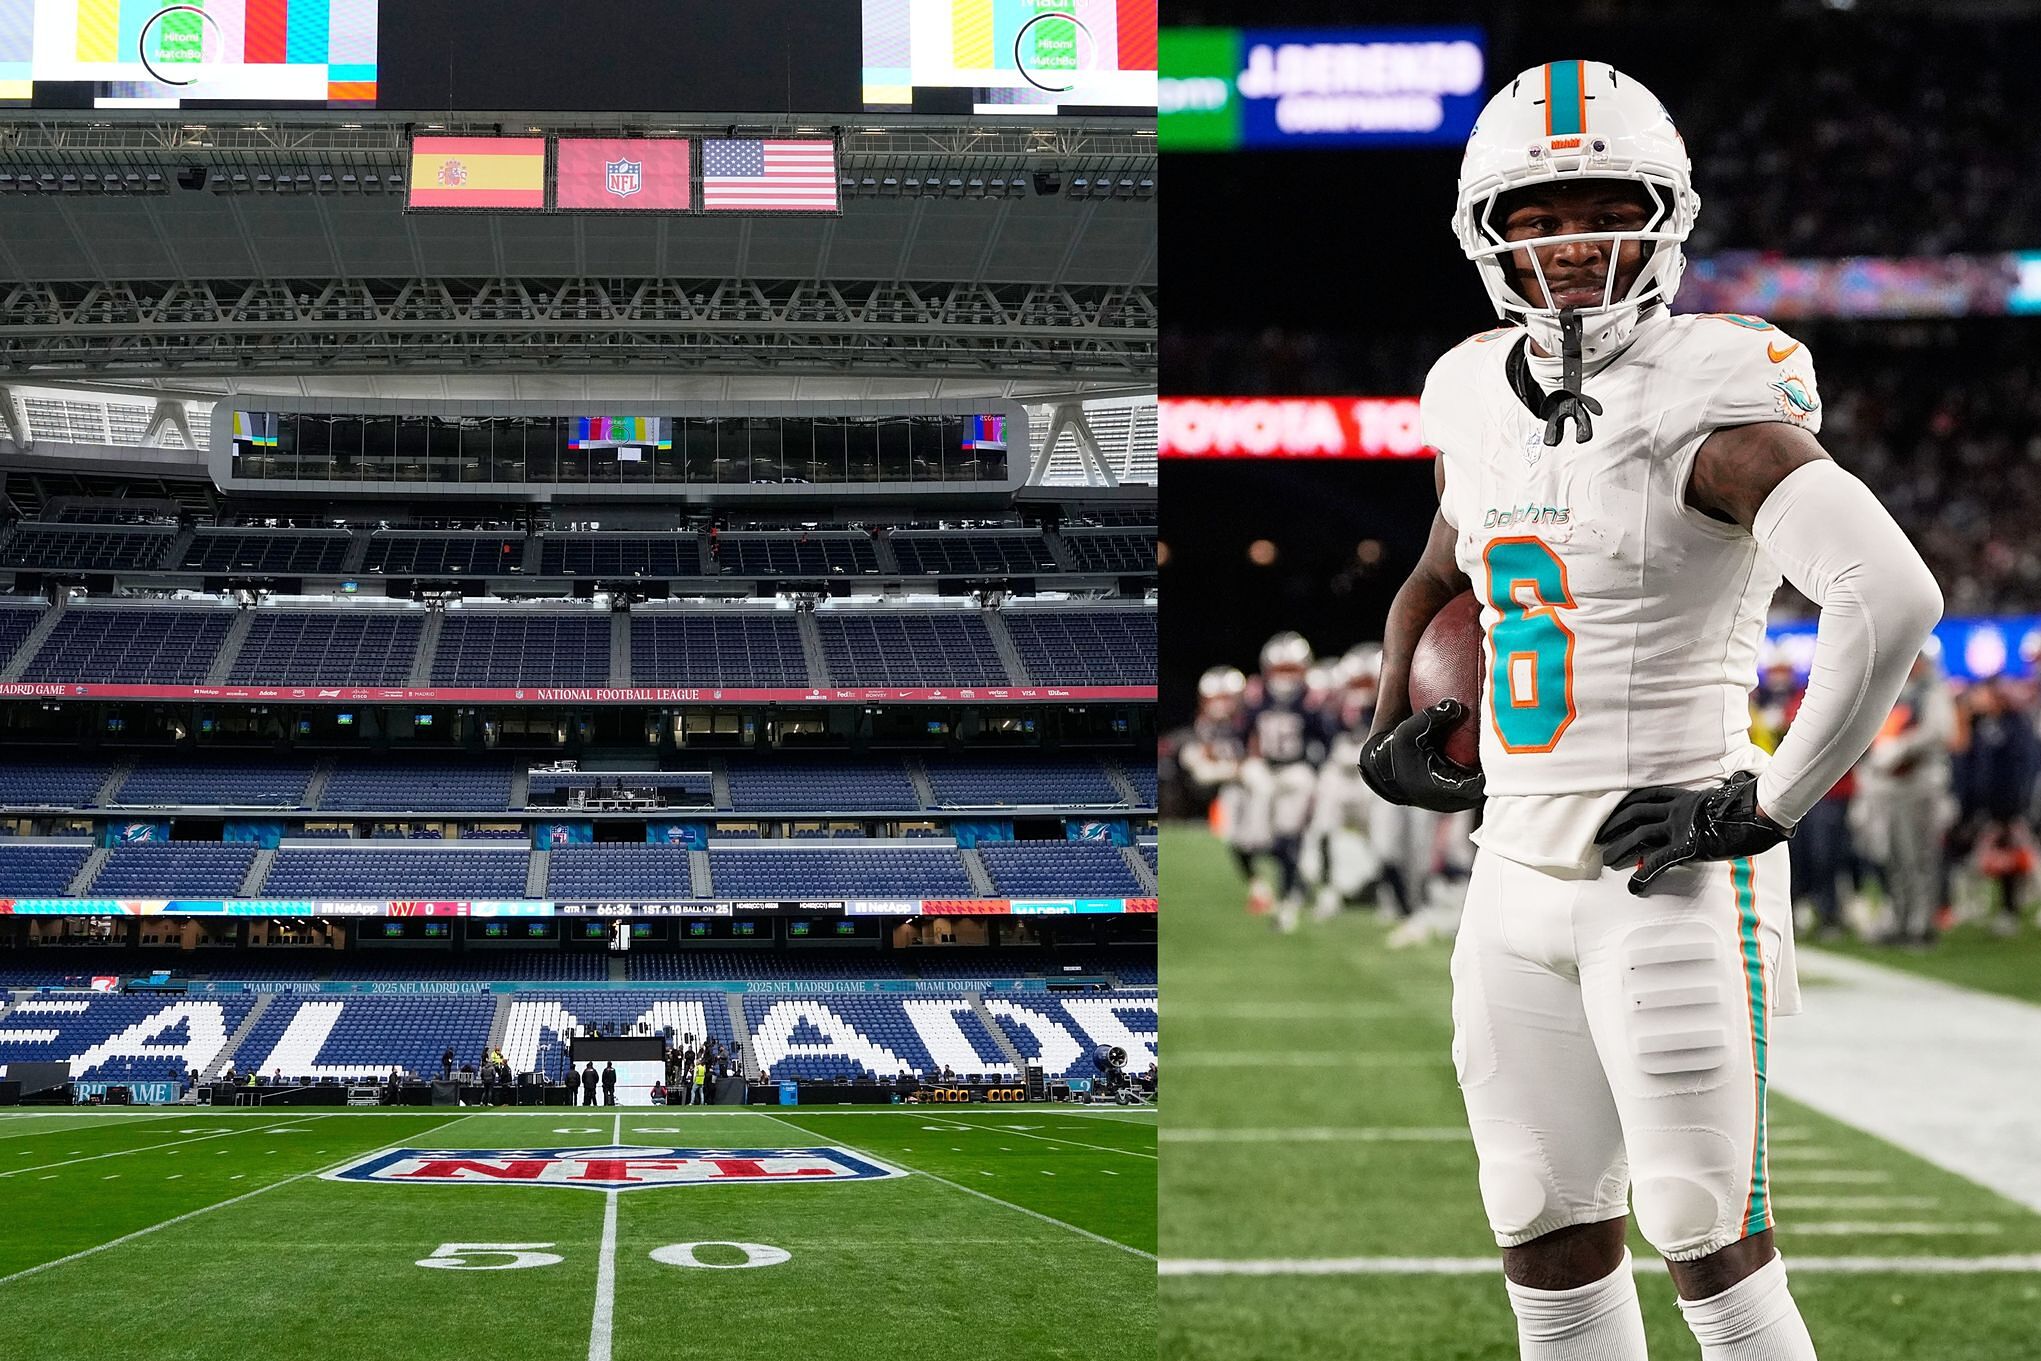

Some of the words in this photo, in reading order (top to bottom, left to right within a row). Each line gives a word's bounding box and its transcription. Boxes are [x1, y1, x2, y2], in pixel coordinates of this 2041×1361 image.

[164, 32, 199, 42] Hitomi
[1038, 39, 1073, 49] Hitomi
[1030, 56, 1082, 66] MatchBo
[610, 175, 637, 191] NFL
[1484, 502, 1570, 529] Dolphns
[1483, 536, 1578, 754] 6
[36, 685, 65, 695] GAME
[537, 689, 592, 700] NATIONAL
[596, 689, 653, 700] FOOTBALL
[657, 689, 699, 700] LEAGUE
[334, 902, 379, 916] NetApp
[424, 903, 434, 915] 0
[564, 905, 580, 913] QTR
[581, 904, 587, 913] 1
[597, 903, 633, 916] 66:36
[642, 904, 661, 915] 1ST
[662, 906, 668, 914] &
[669, 904, 681, 914] 10
[683, 905, 701, 913] BALL
[702, 905, 714, 913] ON
[715, 904, 729, 914] 25
[868, 902, 912, 914] NetApp
[372, 983, 397, 993] 2025
[399, 983, 418, 993] NFL
[420, 983, 459, 993] MADRID
[461, 983, 490, 993] GAME
[747, 982, 772, 992] 2025
[774, 982, 792, 992] NFL
[795, 982, 834, 992] MADRID
[836, 982, 865, 992] GAME
[915, 981, 944, 991] MIAMI
[947, 981, 992, 991] DOLPHINS
[115, 1084, 167, 1102] AME
[392, 1158, 839, 1182] NFL
